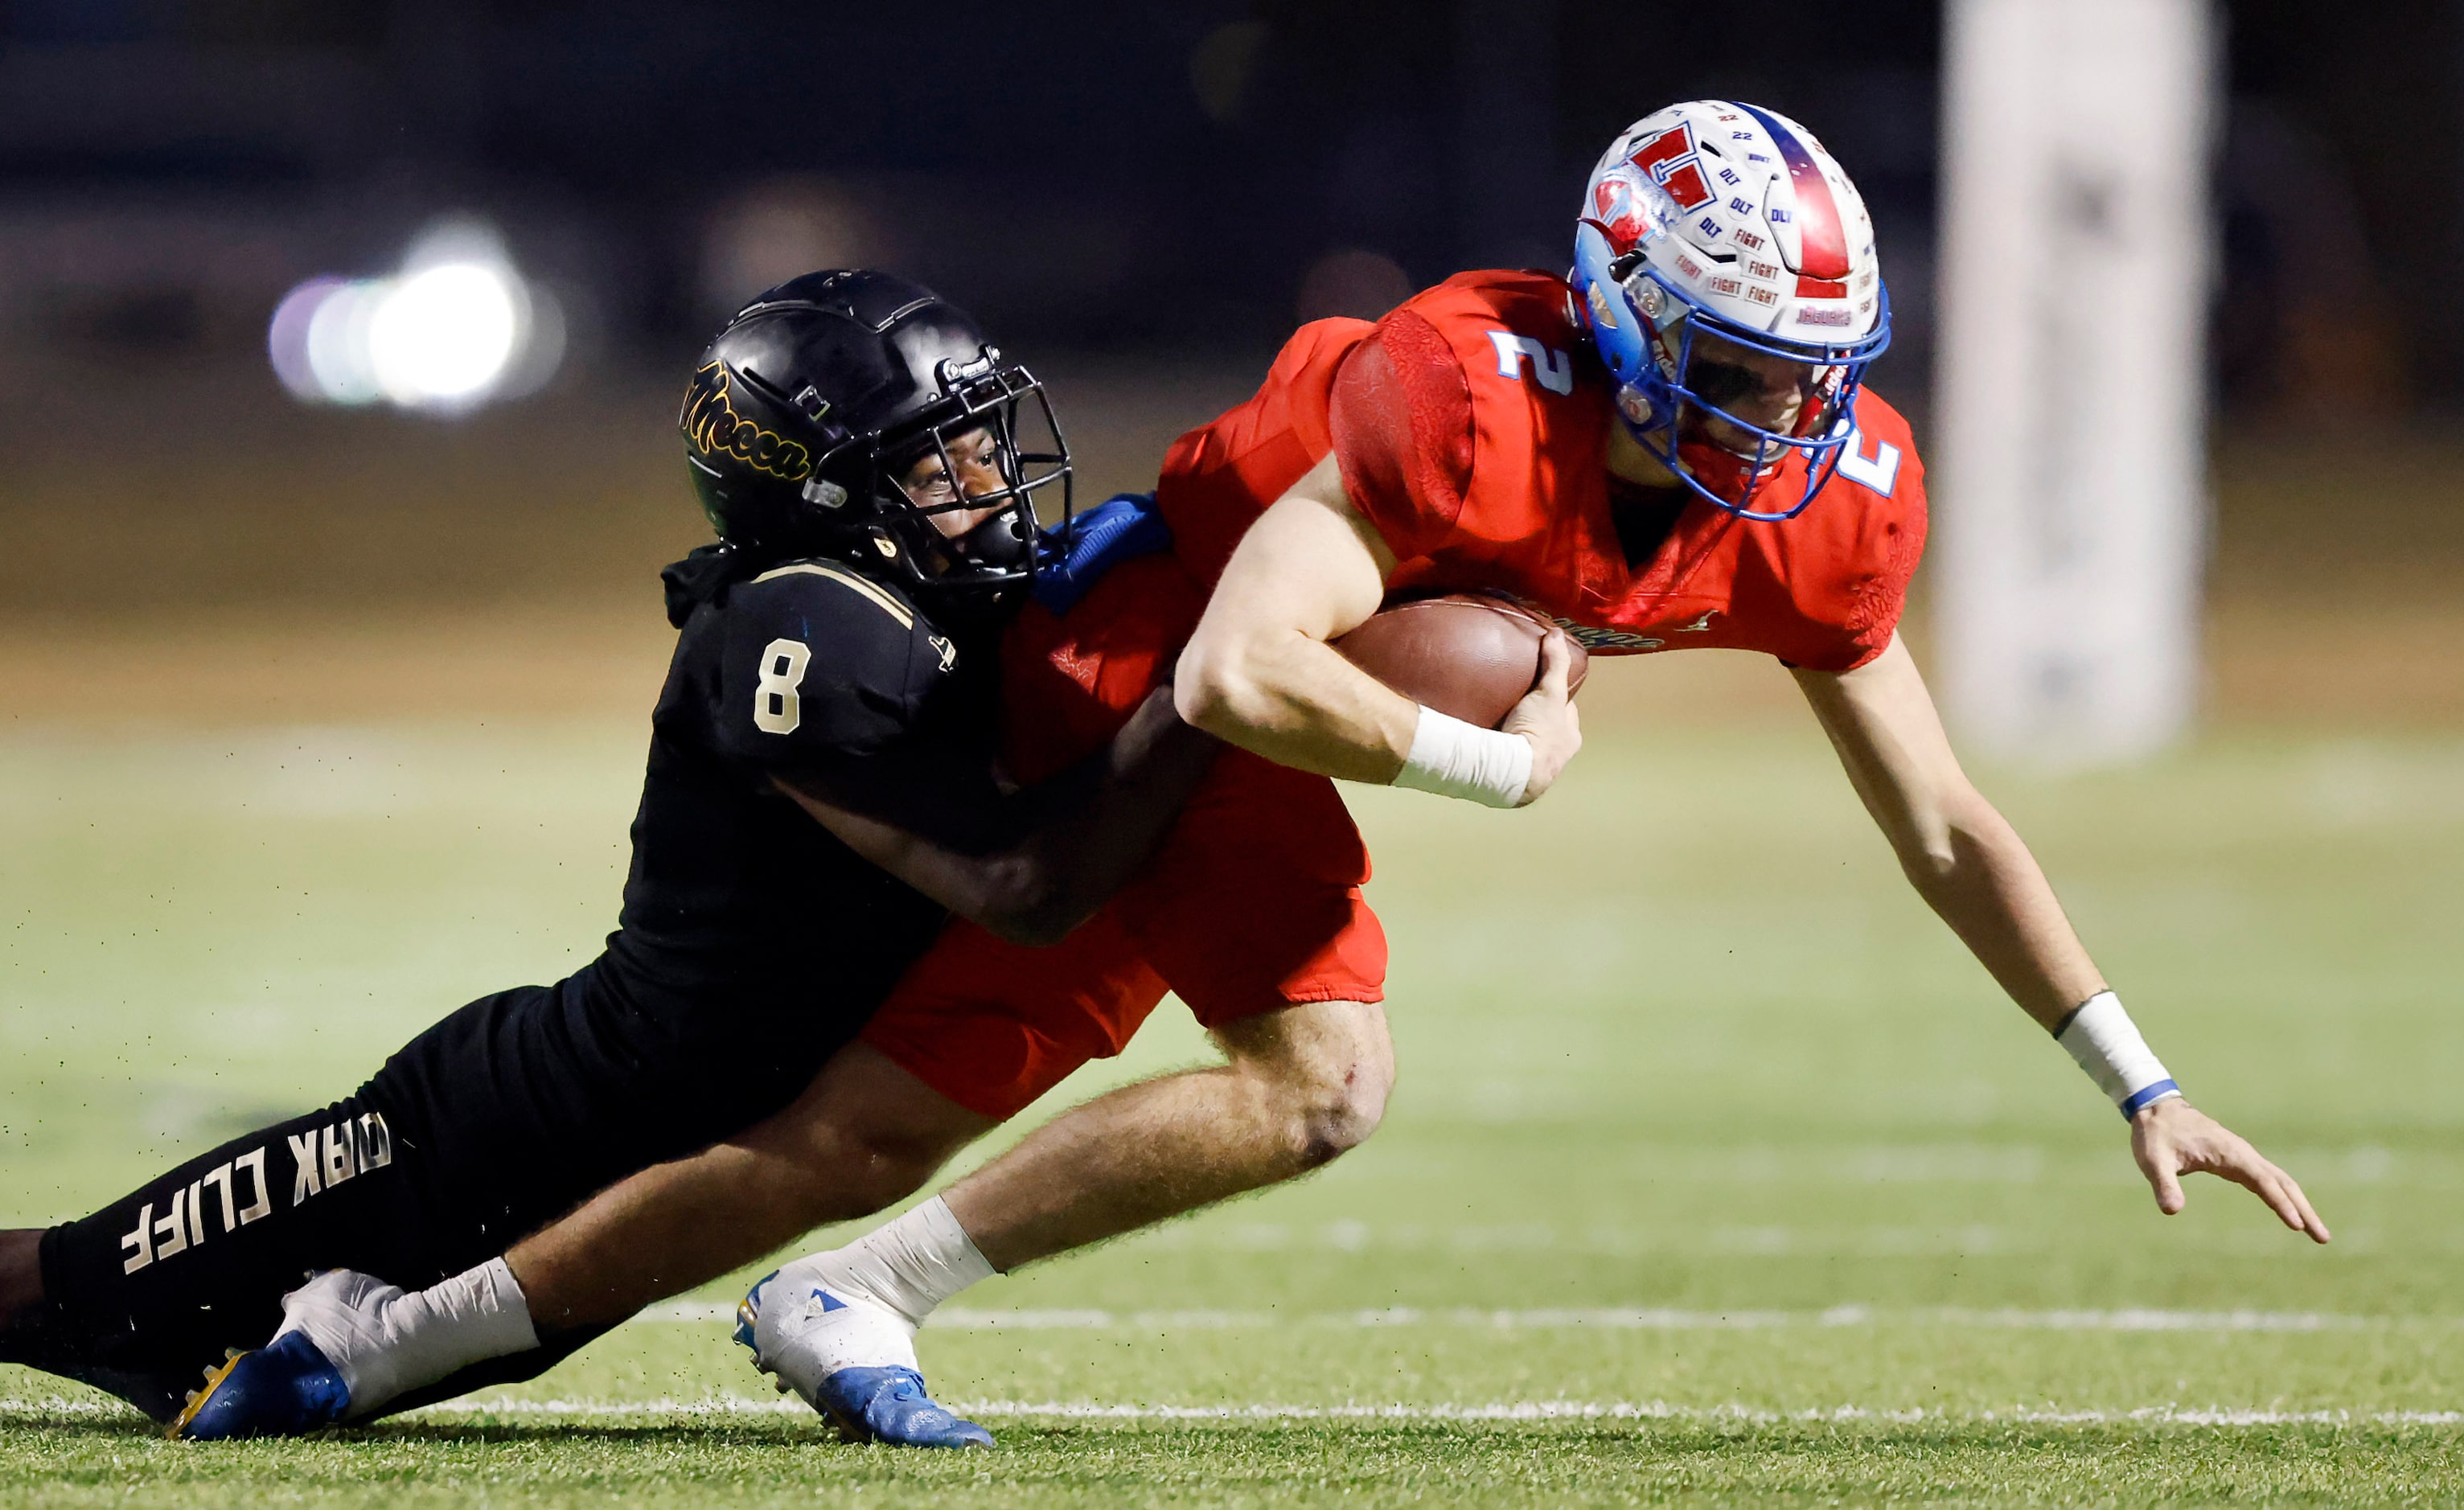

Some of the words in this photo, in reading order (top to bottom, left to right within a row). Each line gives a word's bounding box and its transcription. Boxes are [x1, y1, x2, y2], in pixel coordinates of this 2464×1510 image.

[1731, 130, 1753, 141] 22
[1719, 167, 1742, 187] DLT
[1730, 196, 1755, 215] DLT
[1698, 216, 1723, 238] DLT
[1734, 228, 1766, 252] FIGHT
[1675, 254, 1703, 280] FIGHT
[1748, 261, 1780, 281] FIGHT
[1711, 277, 1743, 295] FIGHT
[1748, 285, 1779, 306] FIGHT
[1484, 330, 1574, 396] 2
[678, 357, 811, 481] Mecca
[754, 638, 811, 735] 8
[287, 1111, 392, 1207] OAK
[121, 1146, 271, 1275] CLIFF
